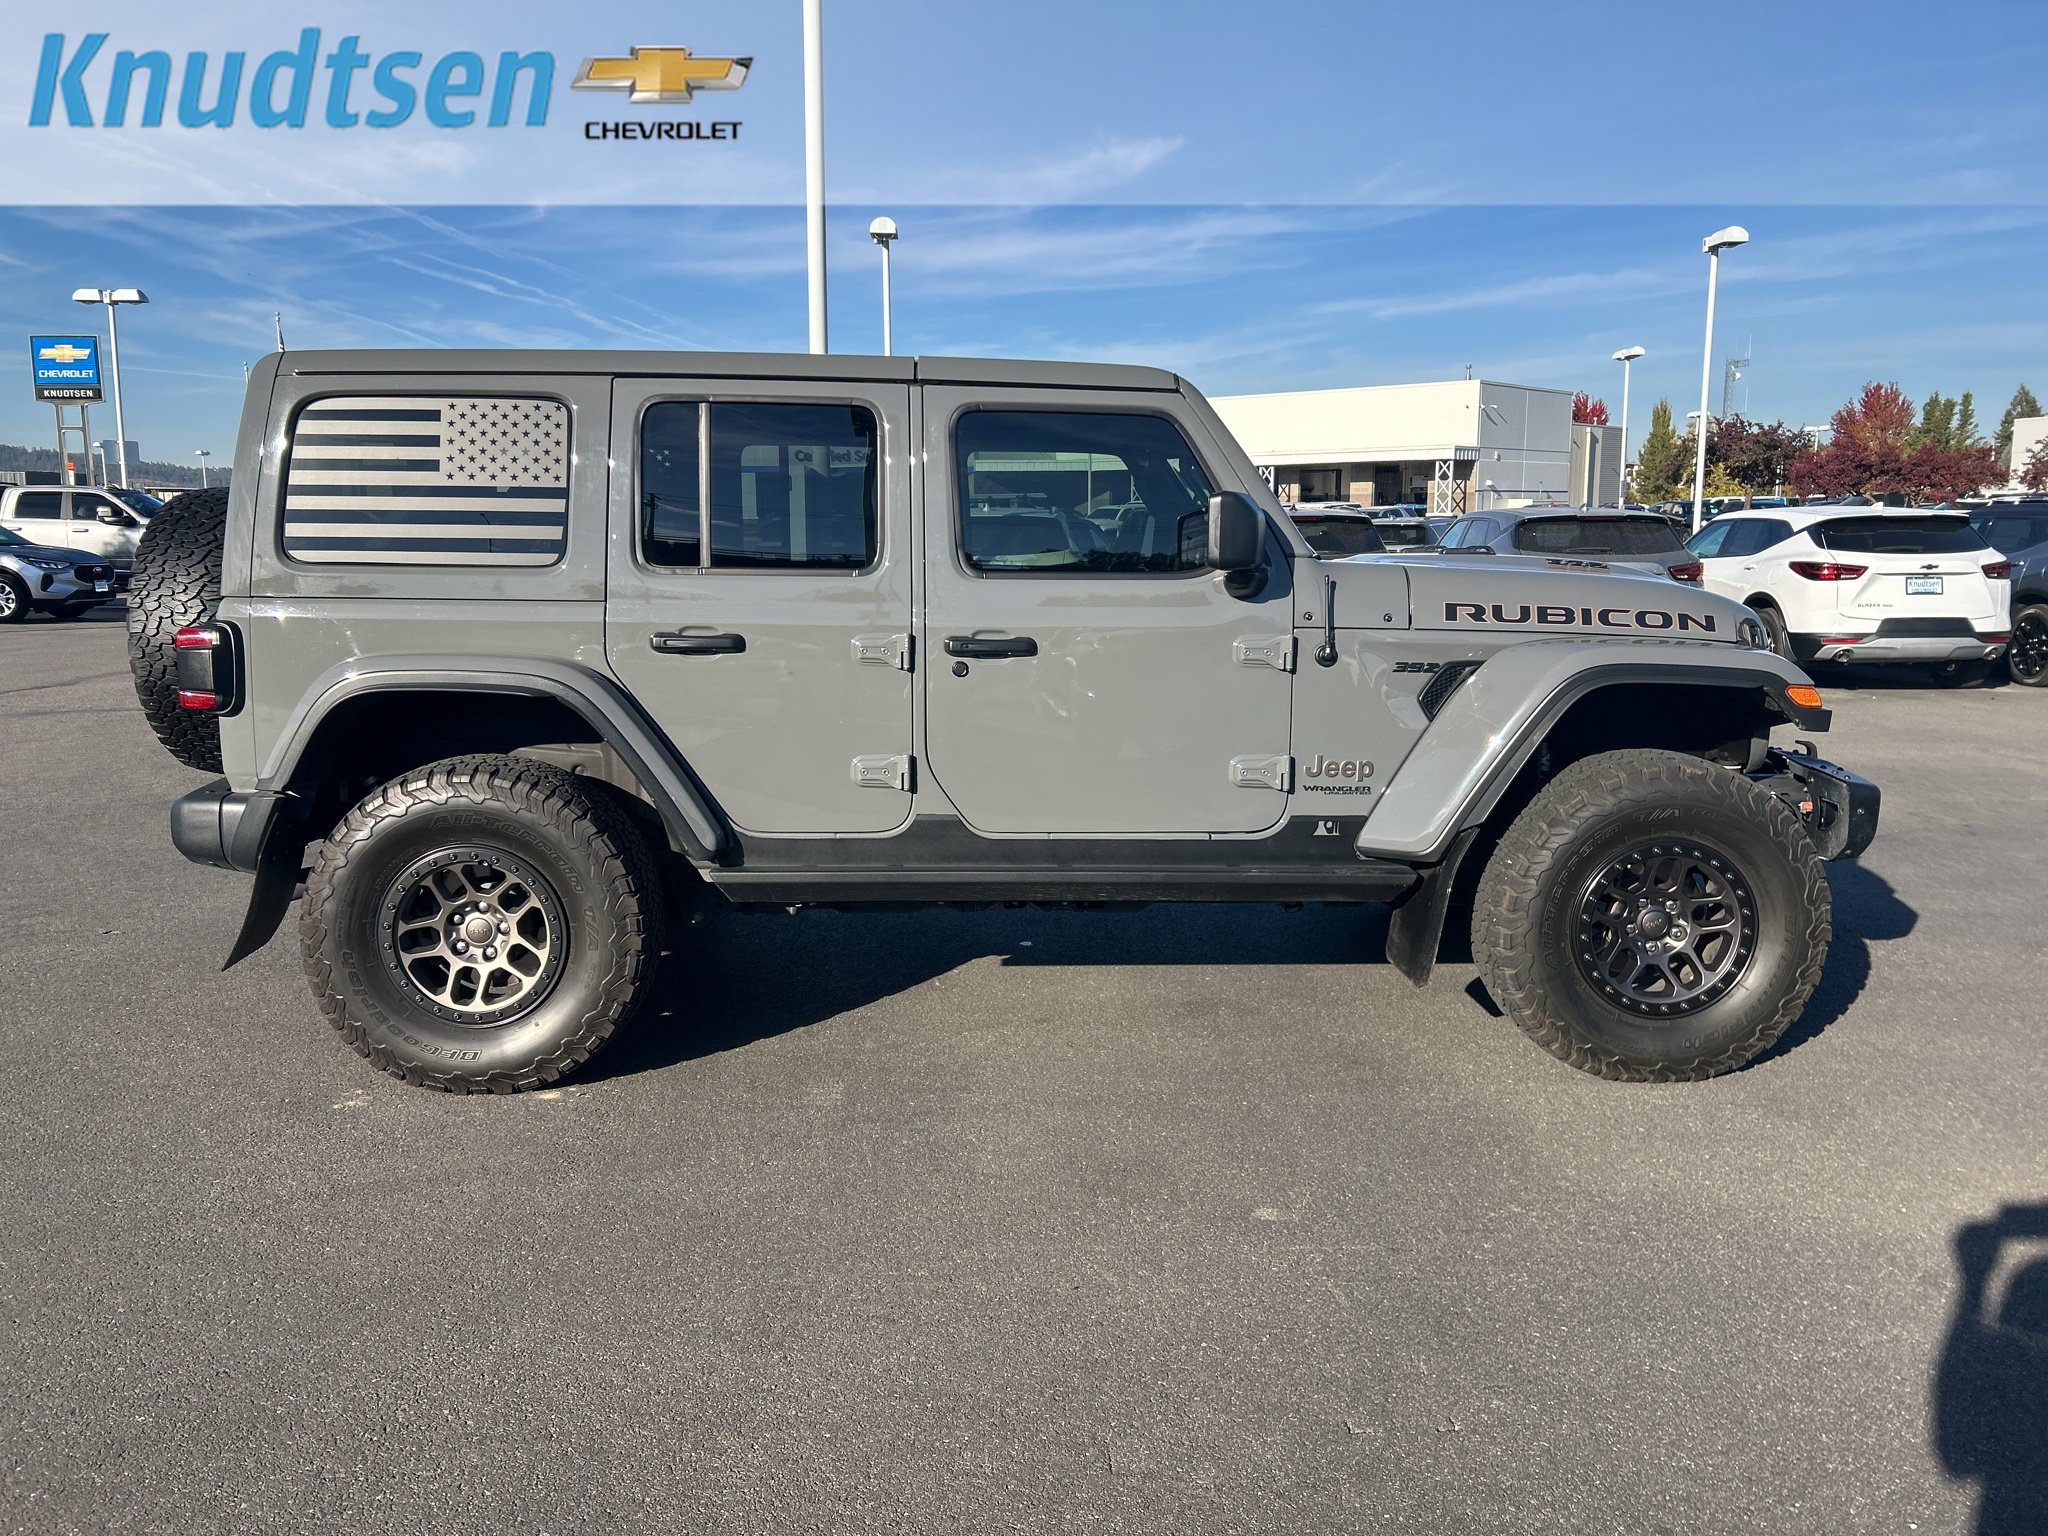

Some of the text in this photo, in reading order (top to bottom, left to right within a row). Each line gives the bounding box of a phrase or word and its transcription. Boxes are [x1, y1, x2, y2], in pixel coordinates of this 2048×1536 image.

[38, 369, 95, 378] CHEVROLET
[43, 389, 94, 398] KNUDTSEN
[1908, 580, 1941, 588] Knudtsen
[1444, 602, 1718, 633] RUBICON
[1392, 661, 1441, 673] 392
[1303, 754, 1375, 782] Jeep
[342, 950, 483, 1063] BFGoodrich
